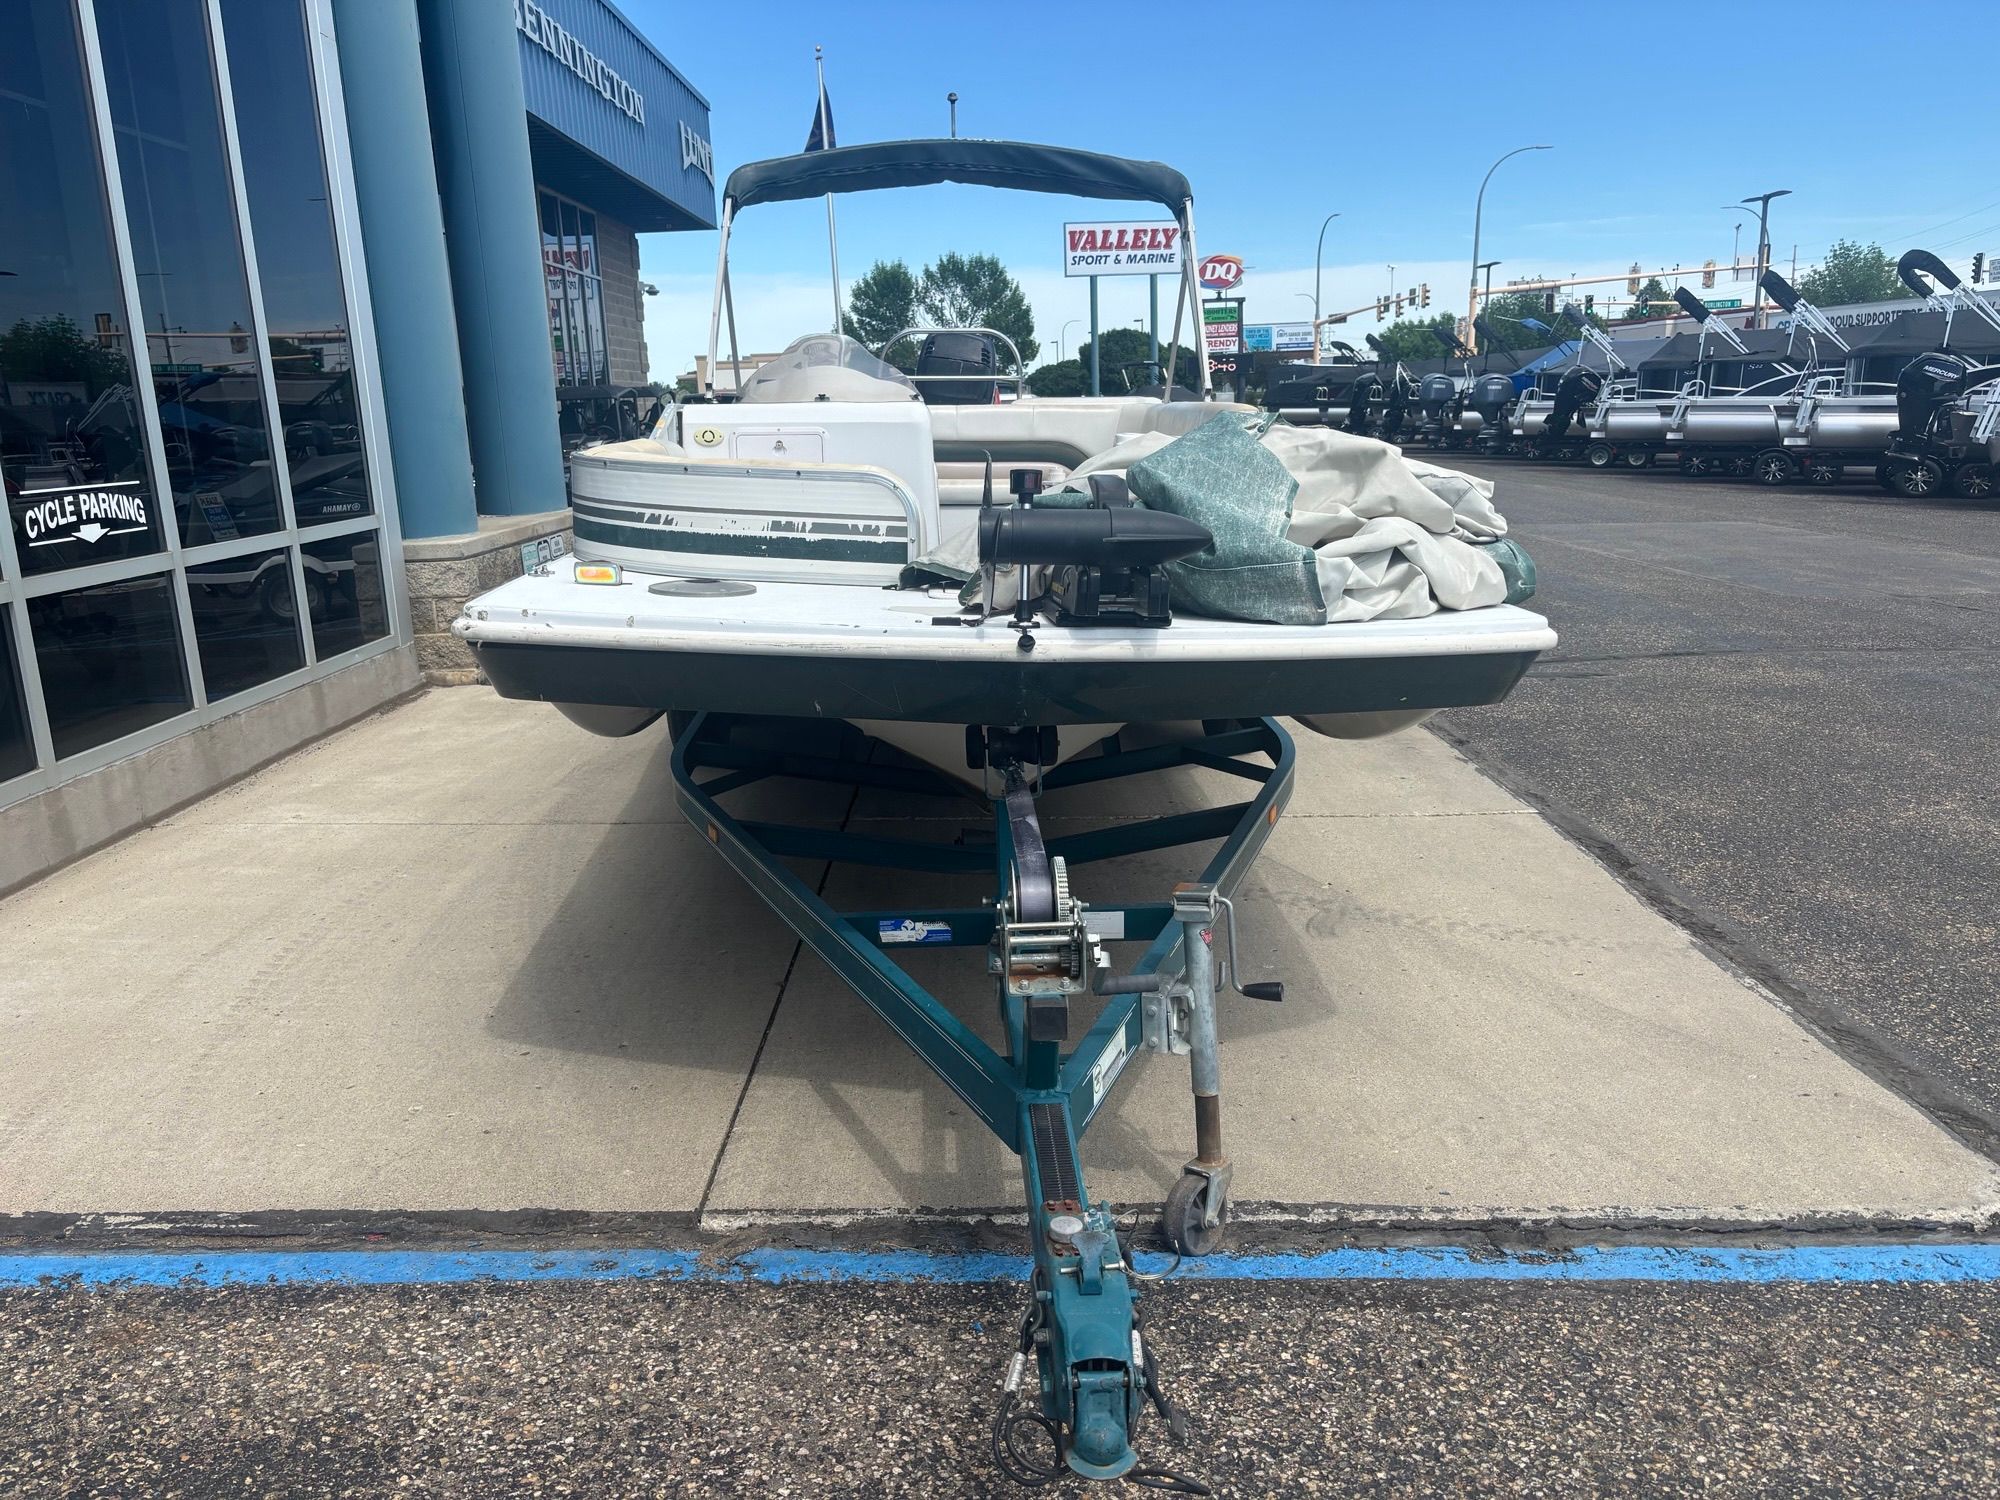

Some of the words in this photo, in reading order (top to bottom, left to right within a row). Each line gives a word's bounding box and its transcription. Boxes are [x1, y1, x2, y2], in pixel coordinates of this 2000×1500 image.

[1068, 227, 1180, 252] VALLELY
[1070, 254, 1110, 266] SPORT
[1113, 254, 1122, 265] &
[1126, 253, 1176, 265] MARINE
[1203, 262, 1237, 282] DQ
[1923, 365, 1960, 379] MERCURY
[25, 495, 77, 539] CYCLE
[79, 492, 147, 524] PARKING
